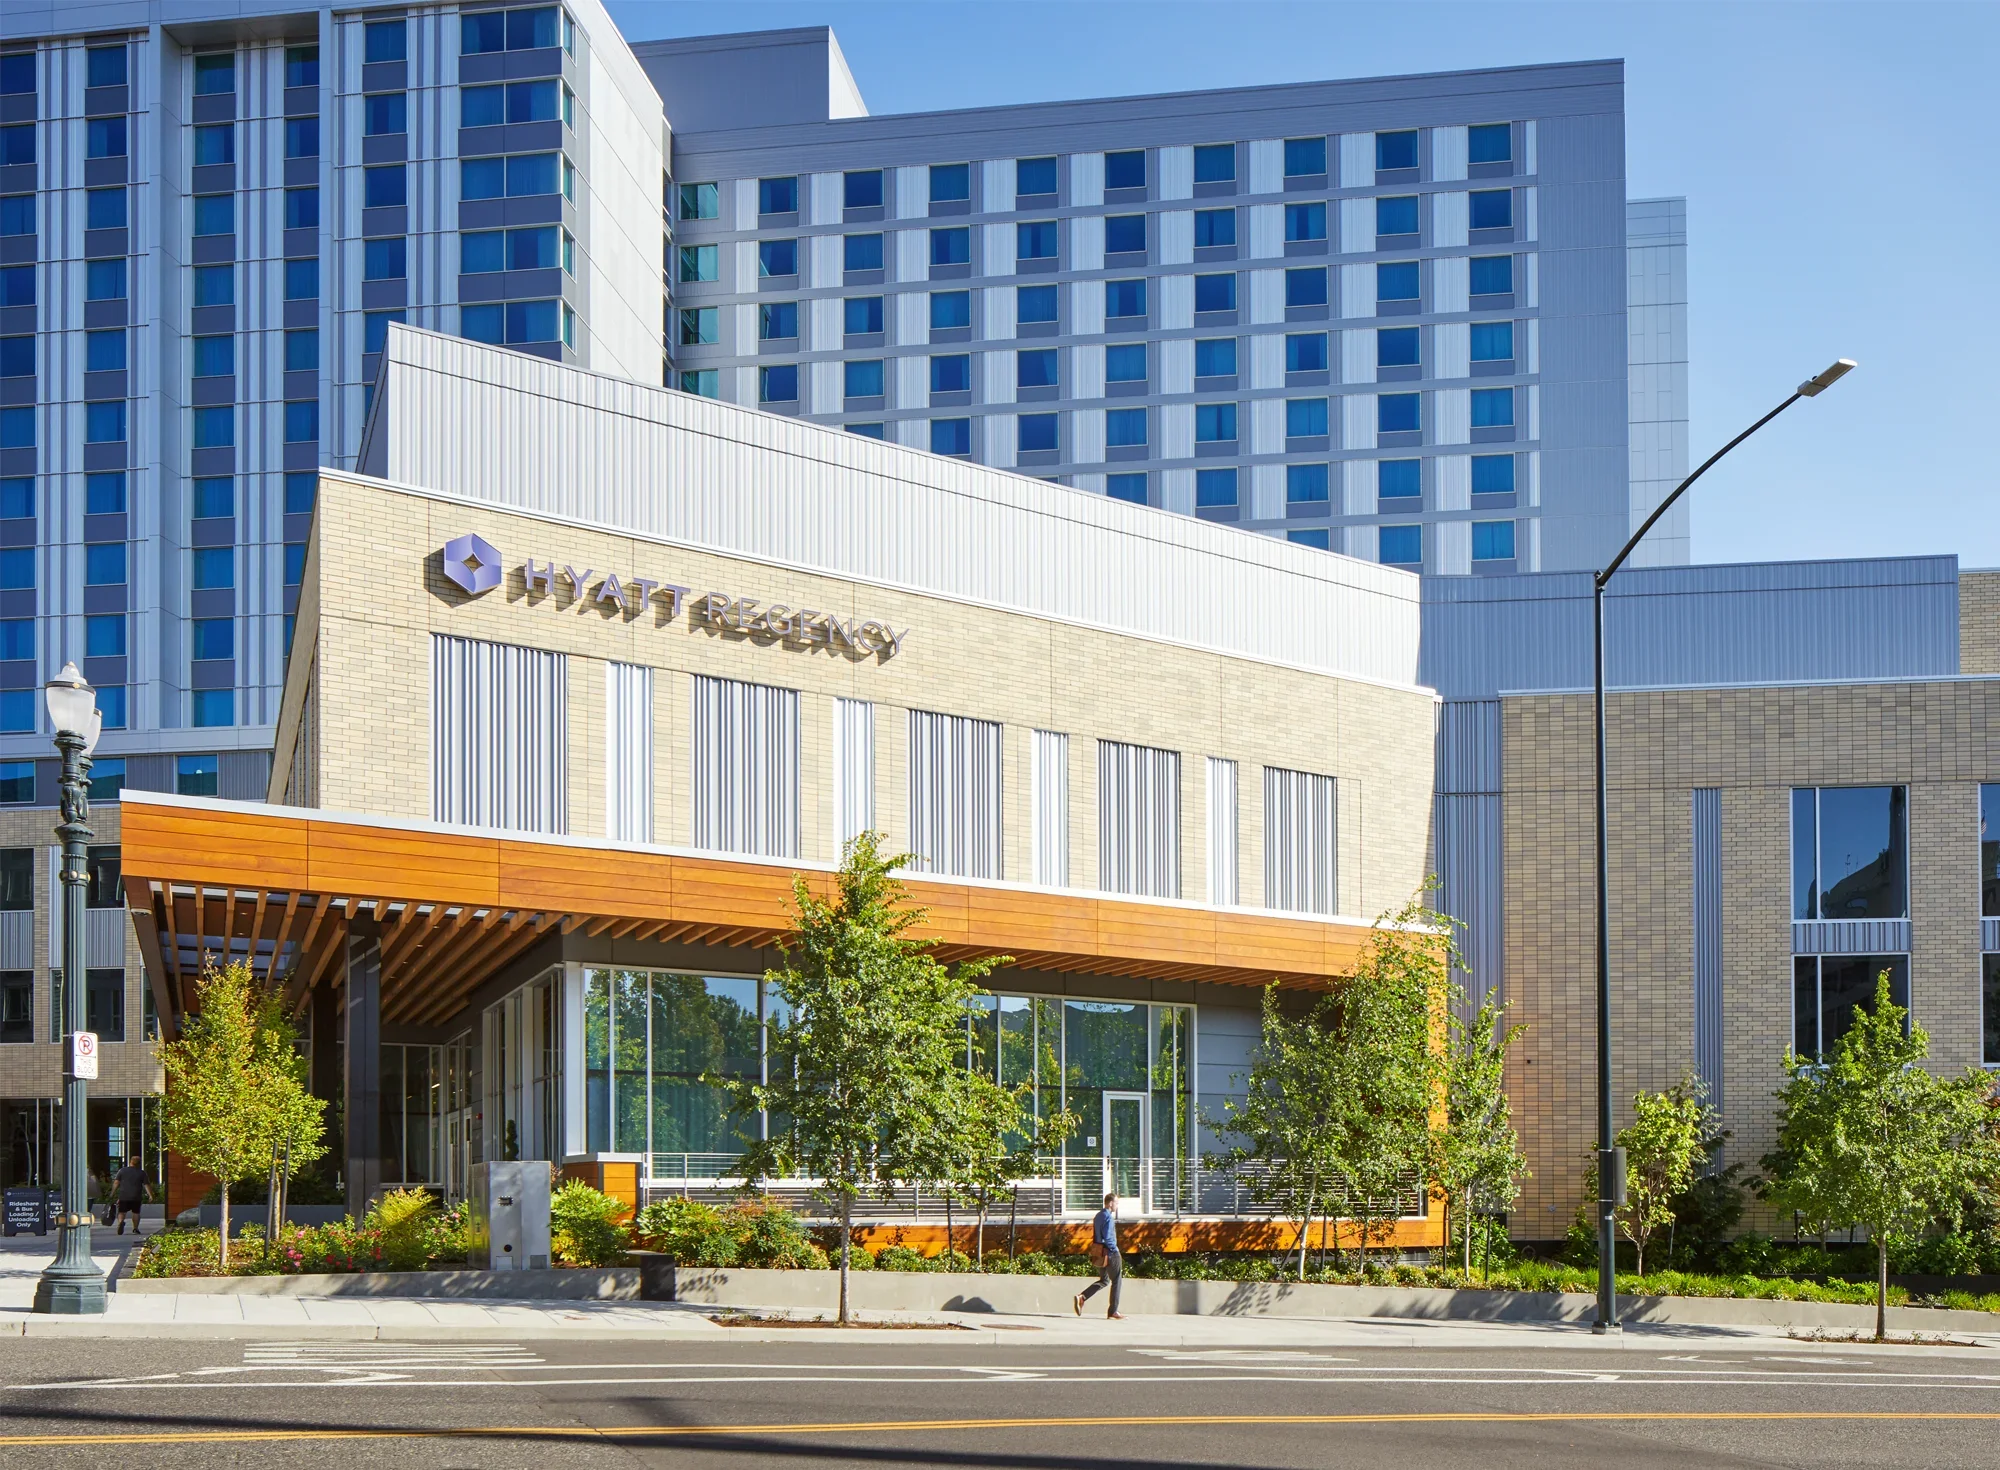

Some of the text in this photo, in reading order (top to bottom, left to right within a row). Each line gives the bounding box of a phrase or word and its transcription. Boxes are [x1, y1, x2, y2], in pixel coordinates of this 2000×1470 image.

[525, 558, 910, 656] HYATT REGENCY
[80, 1058, 92, 1066] THIS
[77, 1066, 95, 1074] BLOCK
